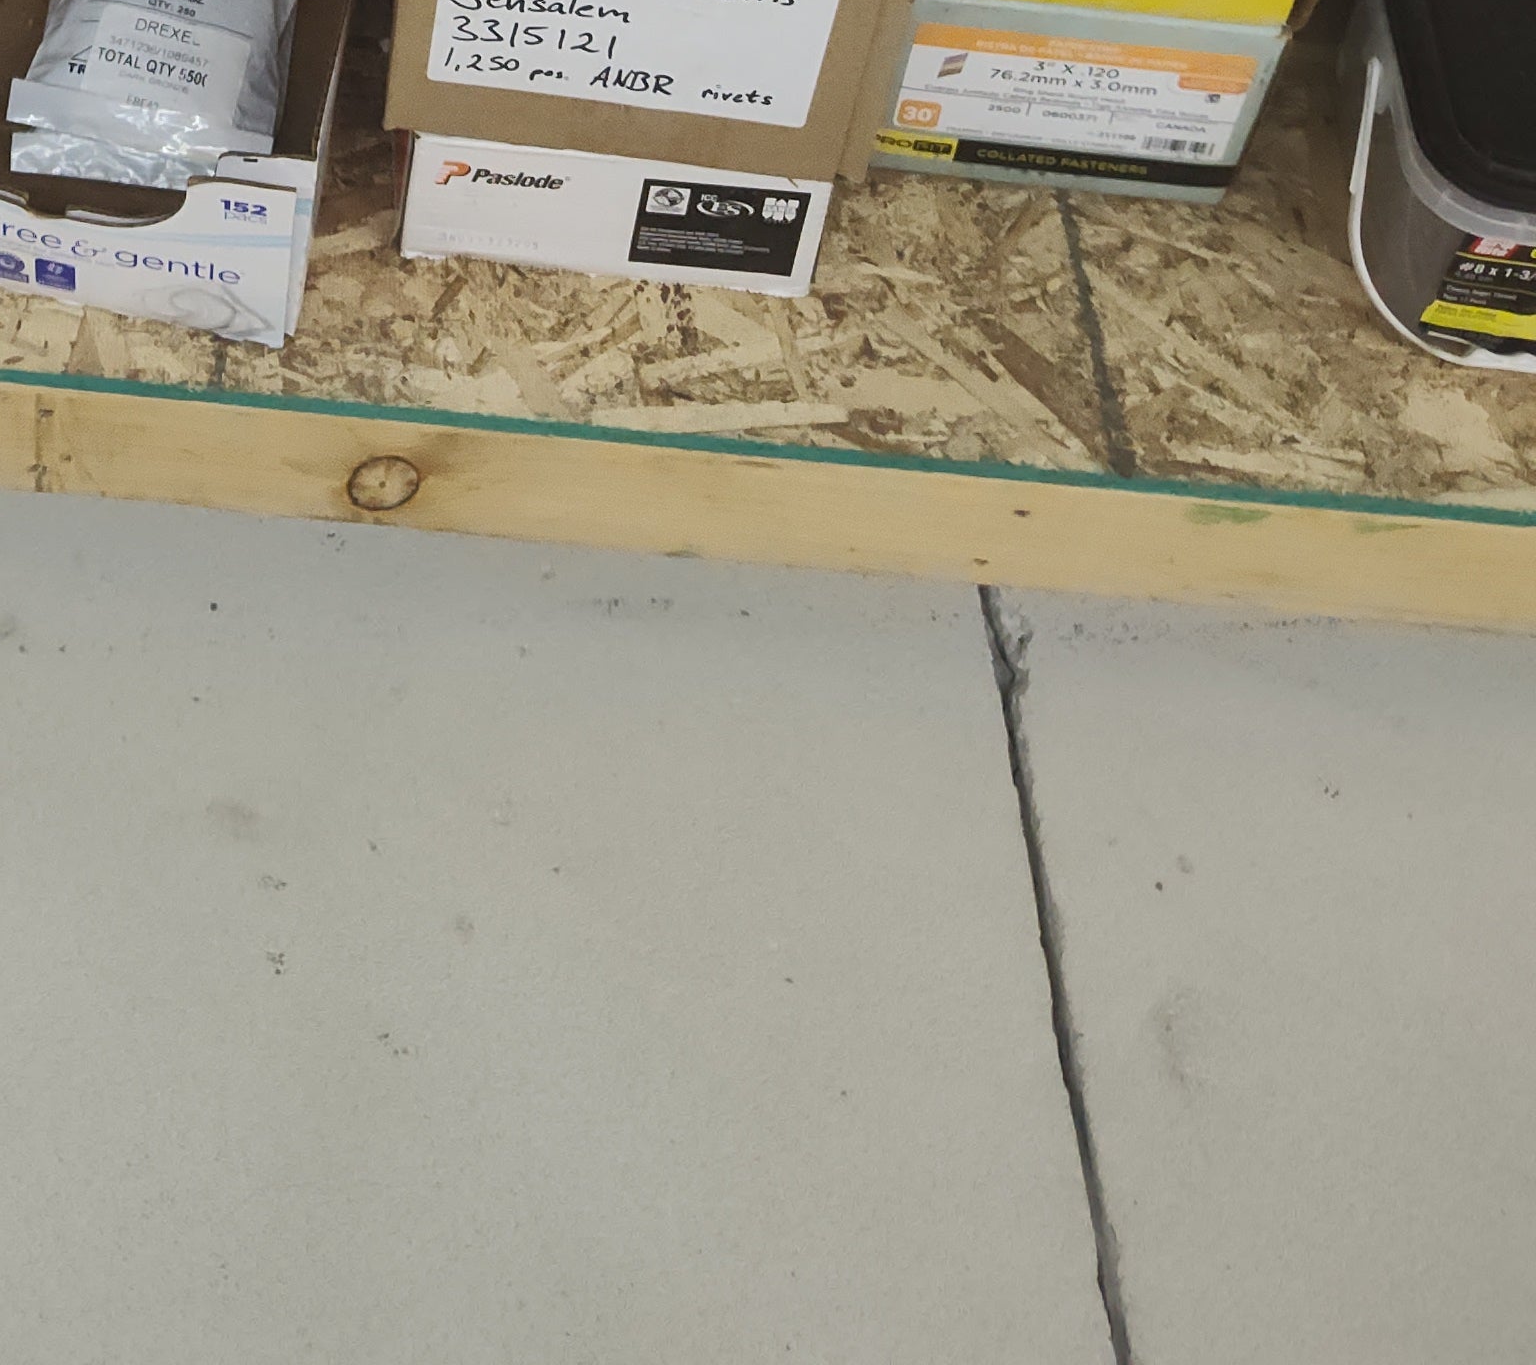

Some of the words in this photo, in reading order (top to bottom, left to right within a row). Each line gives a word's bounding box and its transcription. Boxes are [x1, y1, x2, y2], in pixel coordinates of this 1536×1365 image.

[451, 15, 619, 59] 3315121
[98, 46, 142, 70] TOTAL
[146, 58, 177, 78] QTY
[589, 65, 676, 97] ANBR
[701, 84, 773, 108] rivets
[989, 68, 1068, 88] 76.2mm
[1090, 79, 1158, 97] 3.0mm
[976, 148, 1059, 167] COLLATED
[1060, 157, 1148, 176] FASTENERS
[470, 165, 565, 191] Paslode
[220, 198, 268, 217] 152
[114, 246, 242, 286] gentle
